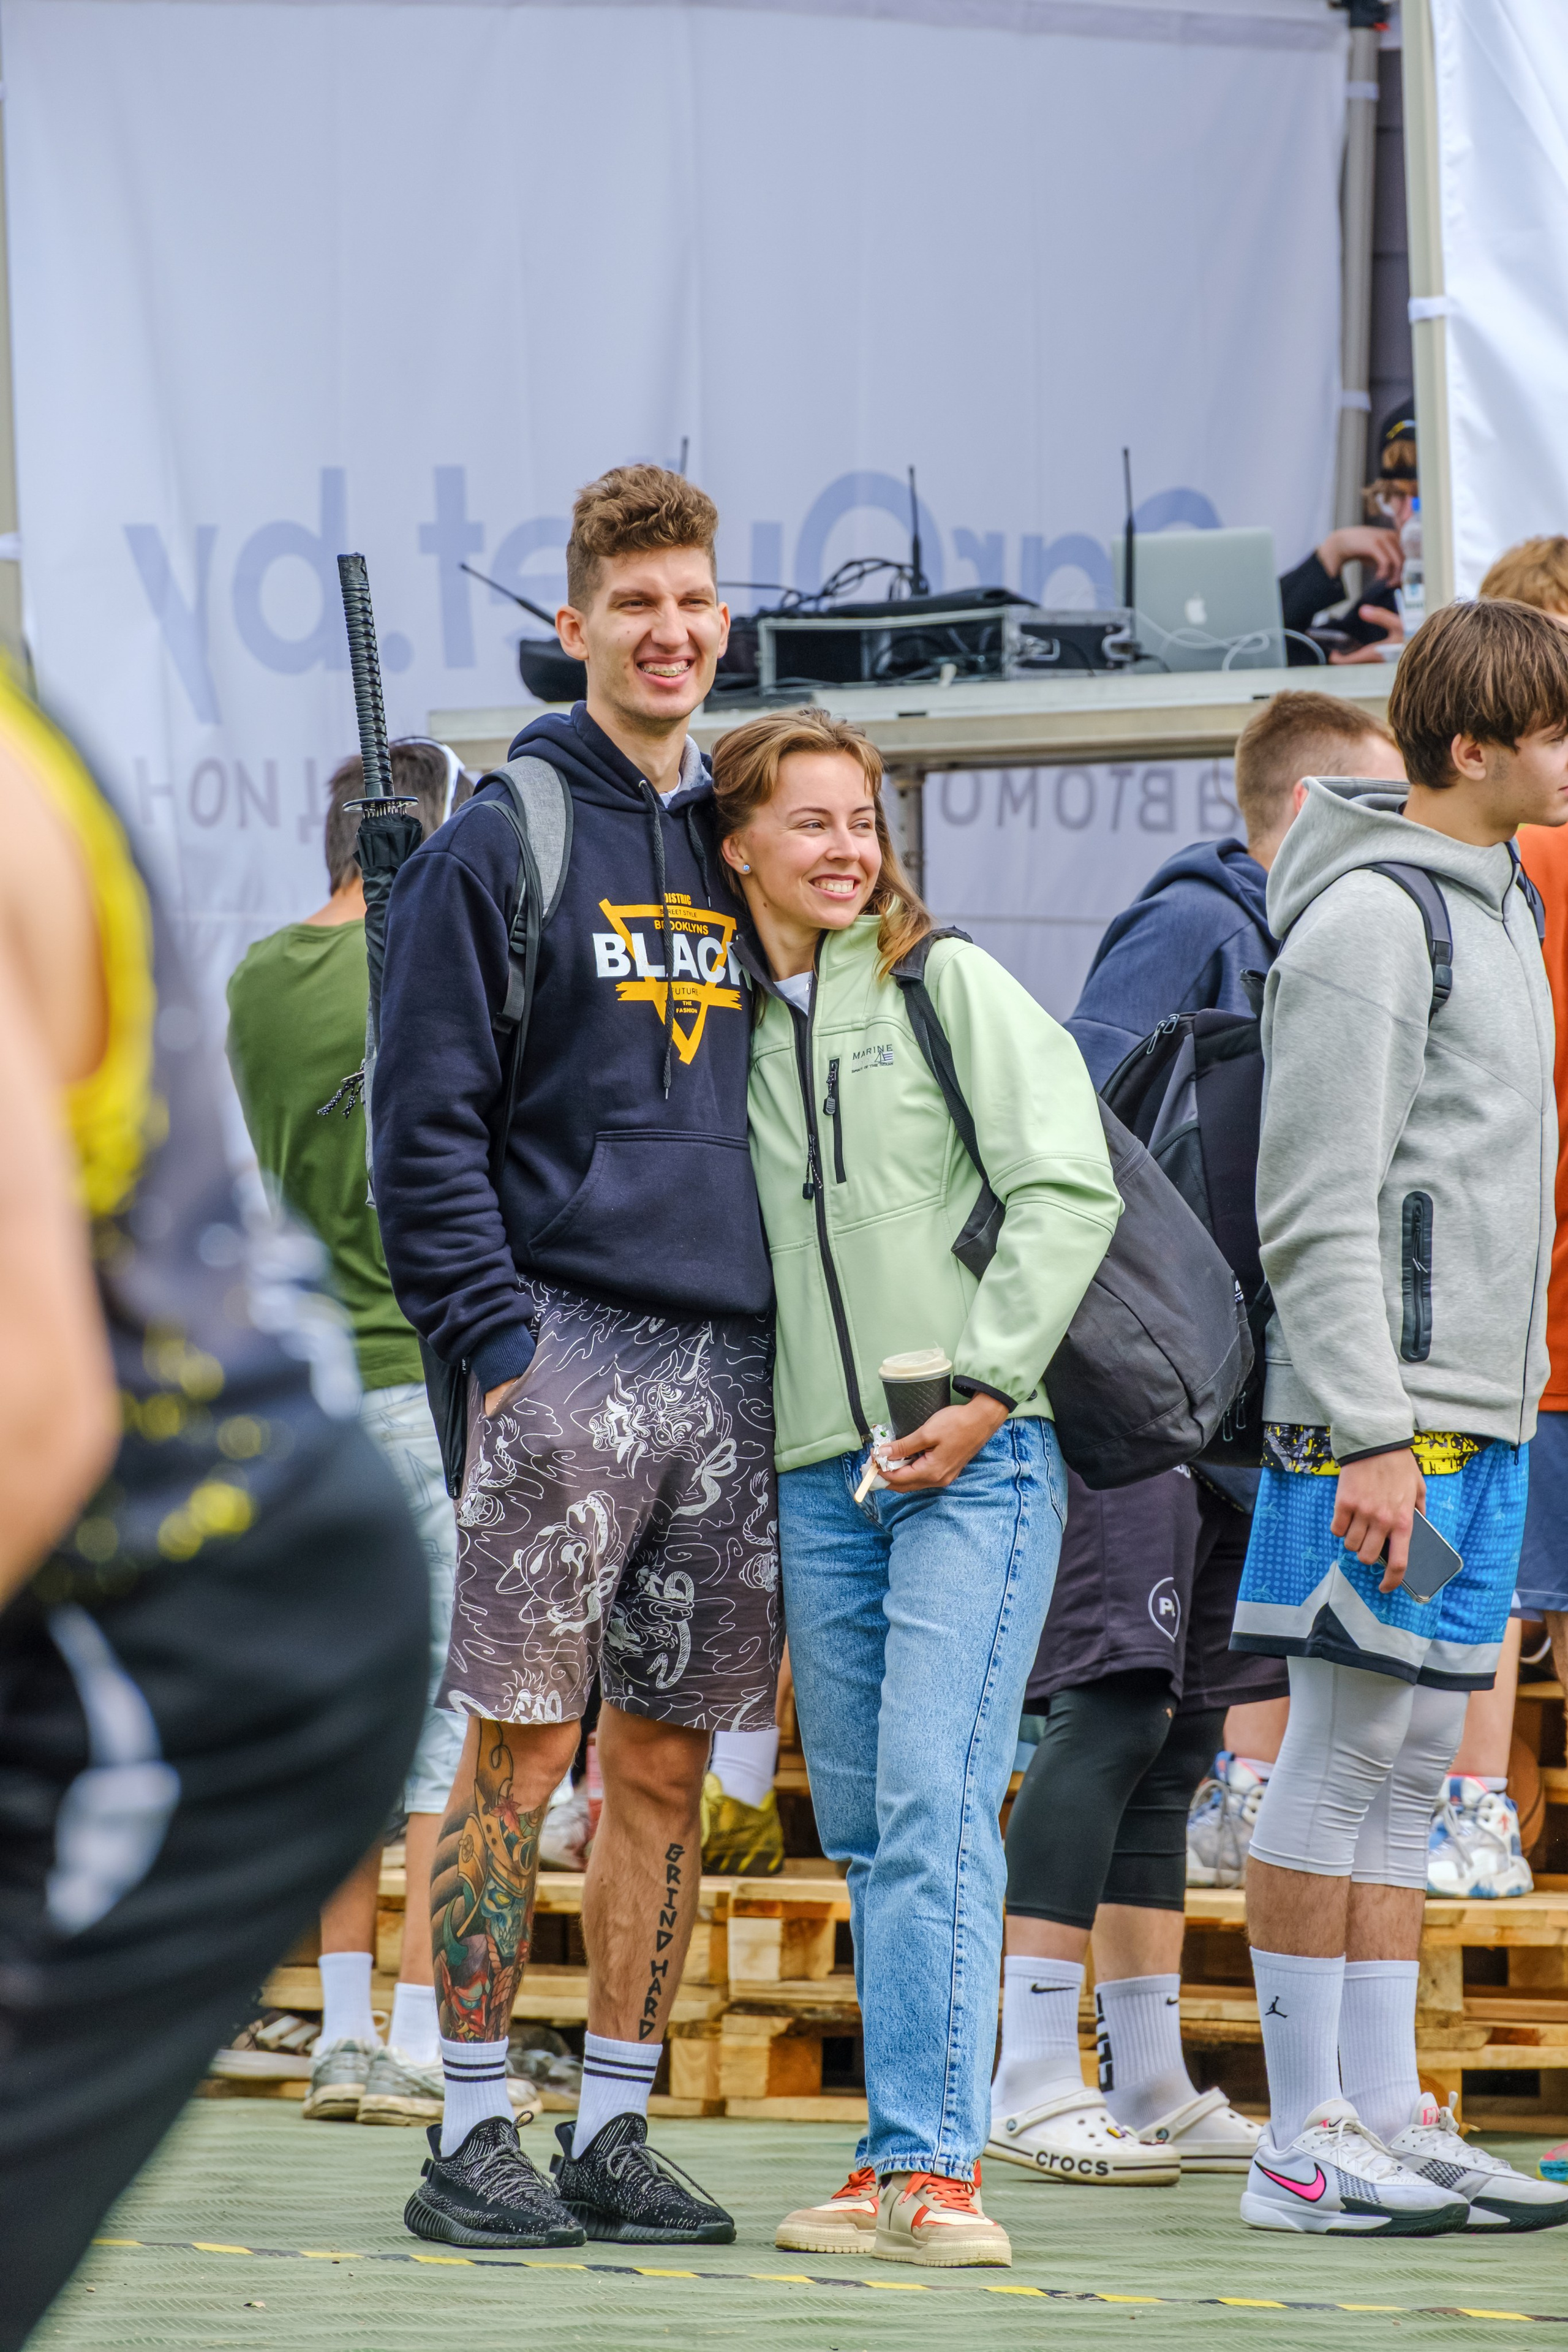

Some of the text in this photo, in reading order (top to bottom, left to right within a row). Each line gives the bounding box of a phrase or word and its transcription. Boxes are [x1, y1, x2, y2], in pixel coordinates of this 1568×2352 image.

[683, 910, 698, 918] STYLE
[852, 1044, 893, 1060] MARINE
[638, 1843, 685, 2041] GRIND HARD
[1036, 2150, 1109, 2176] crocs
